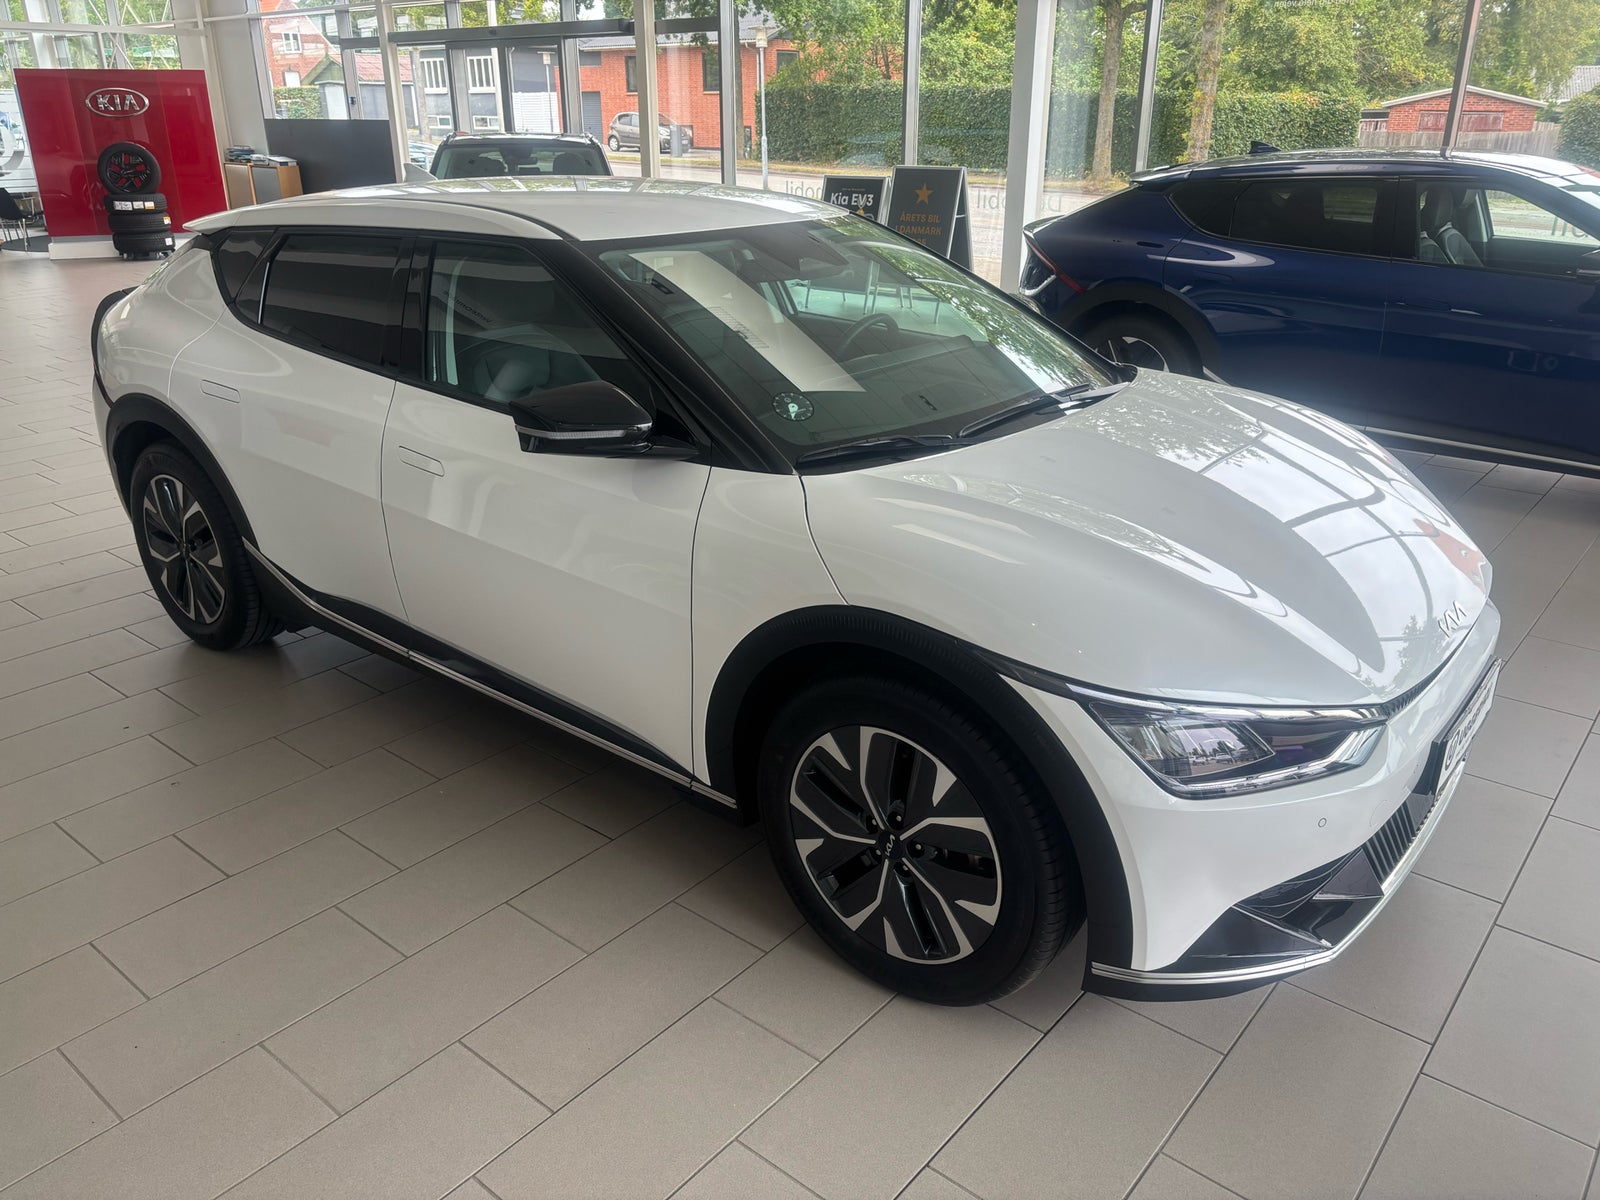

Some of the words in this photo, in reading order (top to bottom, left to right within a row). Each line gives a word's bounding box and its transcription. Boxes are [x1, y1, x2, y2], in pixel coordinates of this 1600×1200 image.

[96, 94, 140, 111] KIA
[830, 192, 849, 205] Kia
[851, 193, 874, 206] EV3
[899, 210, 927, 223] ÅRETS
[927, 214, 941, 224] BIL
[899, 225, 942, 236] DANMARK
